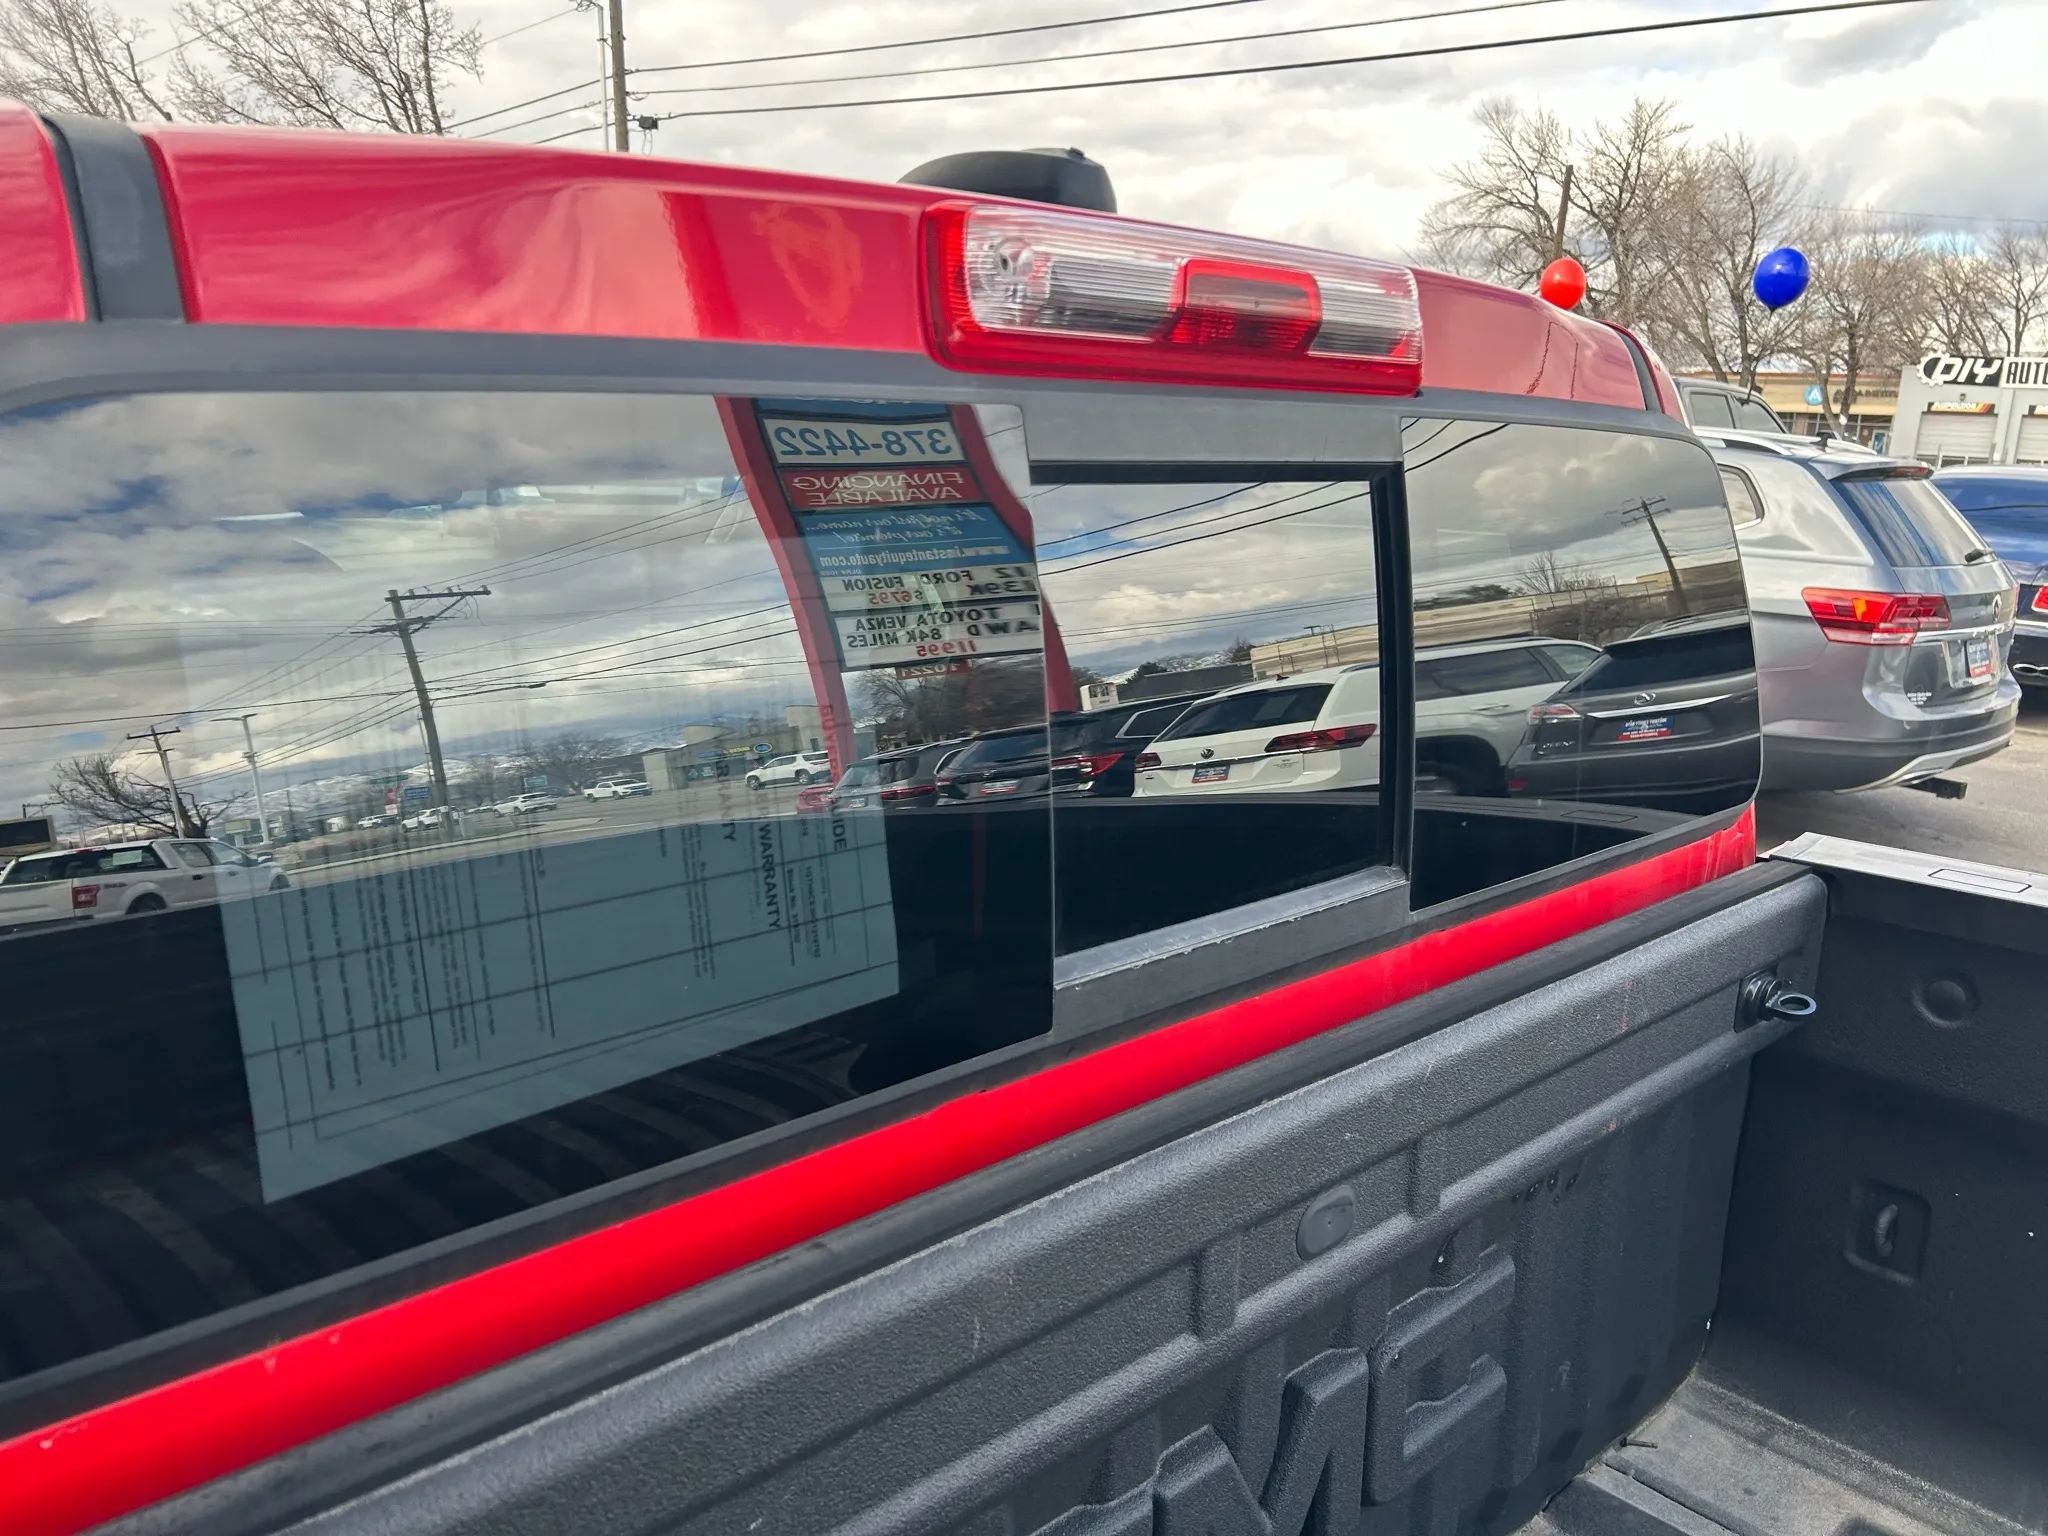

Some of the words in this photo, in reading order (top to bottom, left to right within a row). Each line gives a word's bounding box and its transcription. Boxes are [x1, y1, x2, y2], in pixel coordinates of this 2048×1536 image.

[1931, 357, 2002, 384] DIY
[758, 823, 781, 929] WARRANTY
[1030, 1245, 1515, 1536] MC
